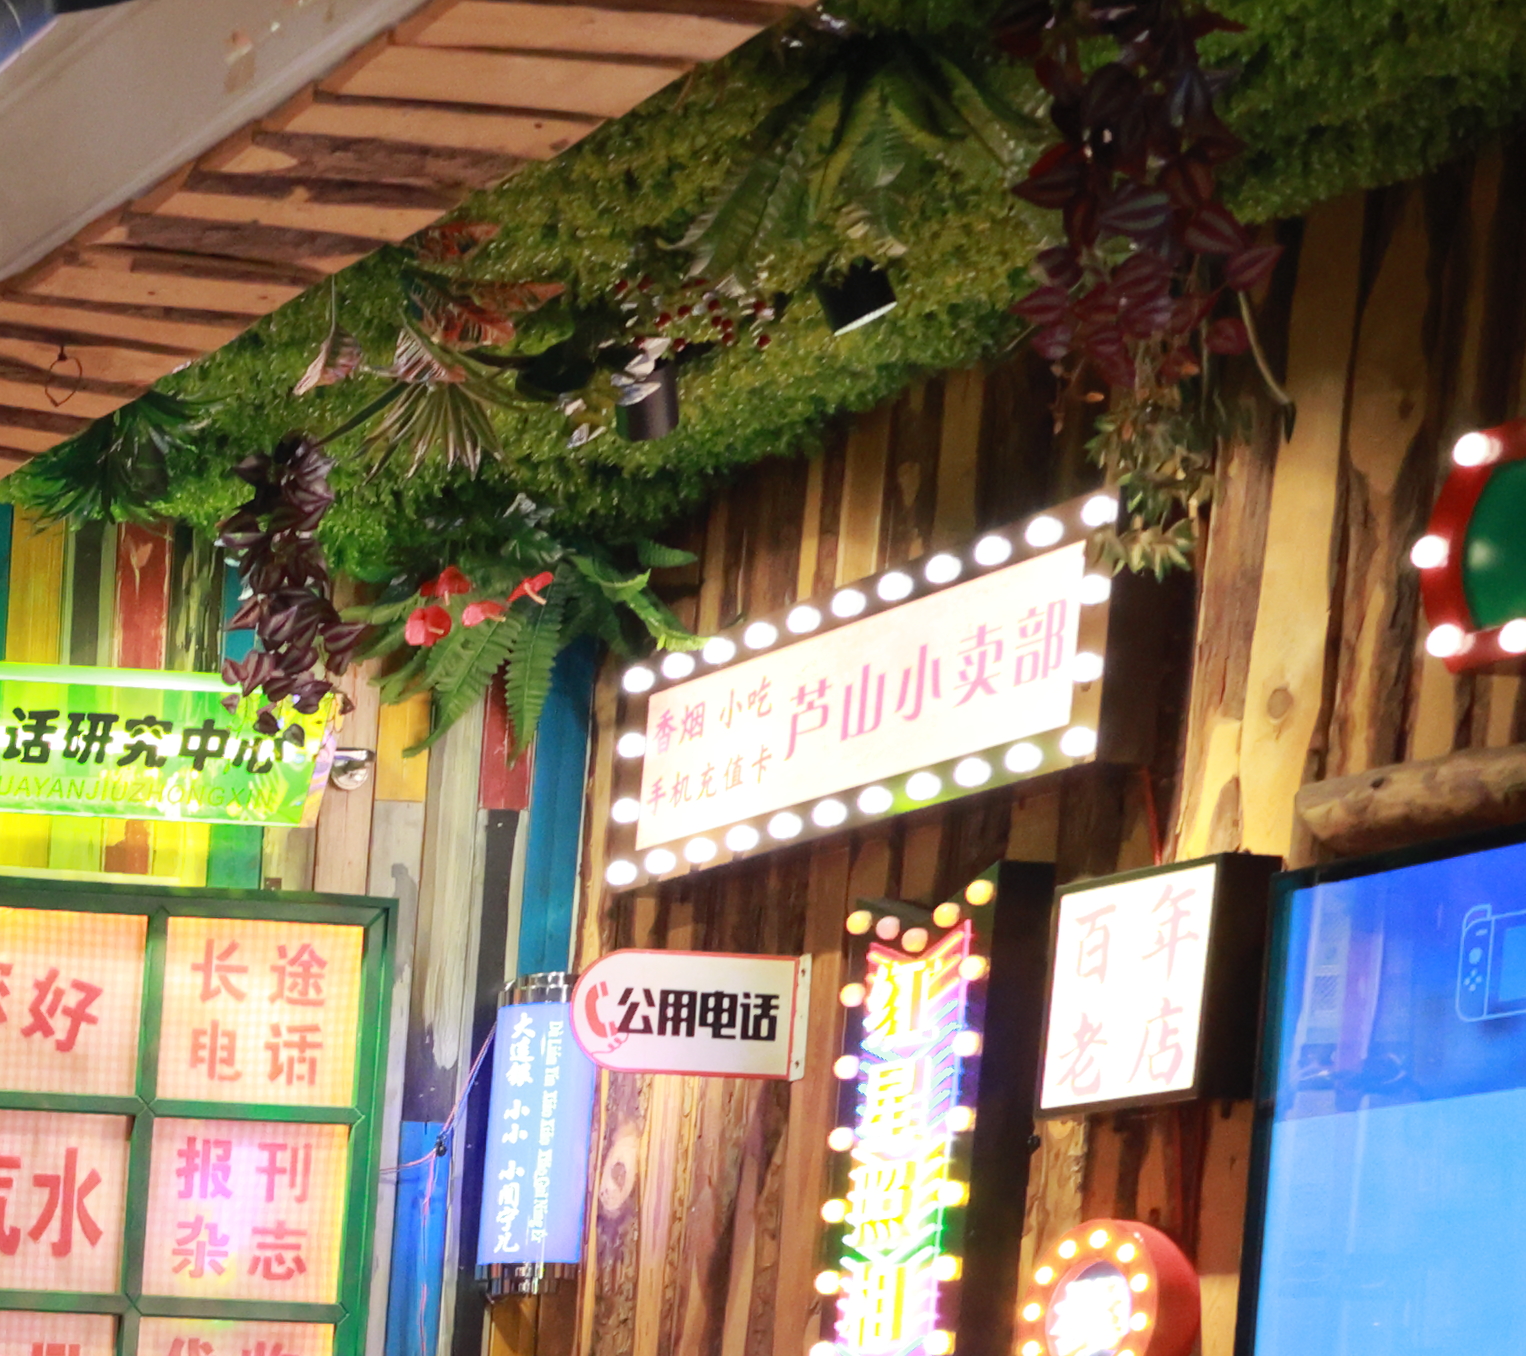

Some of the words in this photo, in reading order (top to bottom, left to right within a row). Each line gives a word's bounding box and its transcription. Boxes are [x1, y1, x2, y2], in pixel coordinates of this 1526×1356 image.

[785, 598, 1068, 760] 芦山小卖部
[654, 701, 706, 755] 香烟
[719, 676, 773, 729] 小吃
[646, 745, 773, 817] 手机充值卡
[1074, 884, 1200, 984] 百年
[189, 938, 329, 1005] 长途
[617, 987, 780, 1042] 公用电话
[1056, 997, 1184, 1097] 老店
[188, 1019, 324, 1086] 电话
[174, 1136, 312, 1204] 报刊
[170, 1215, 308, 1281] 杂志
